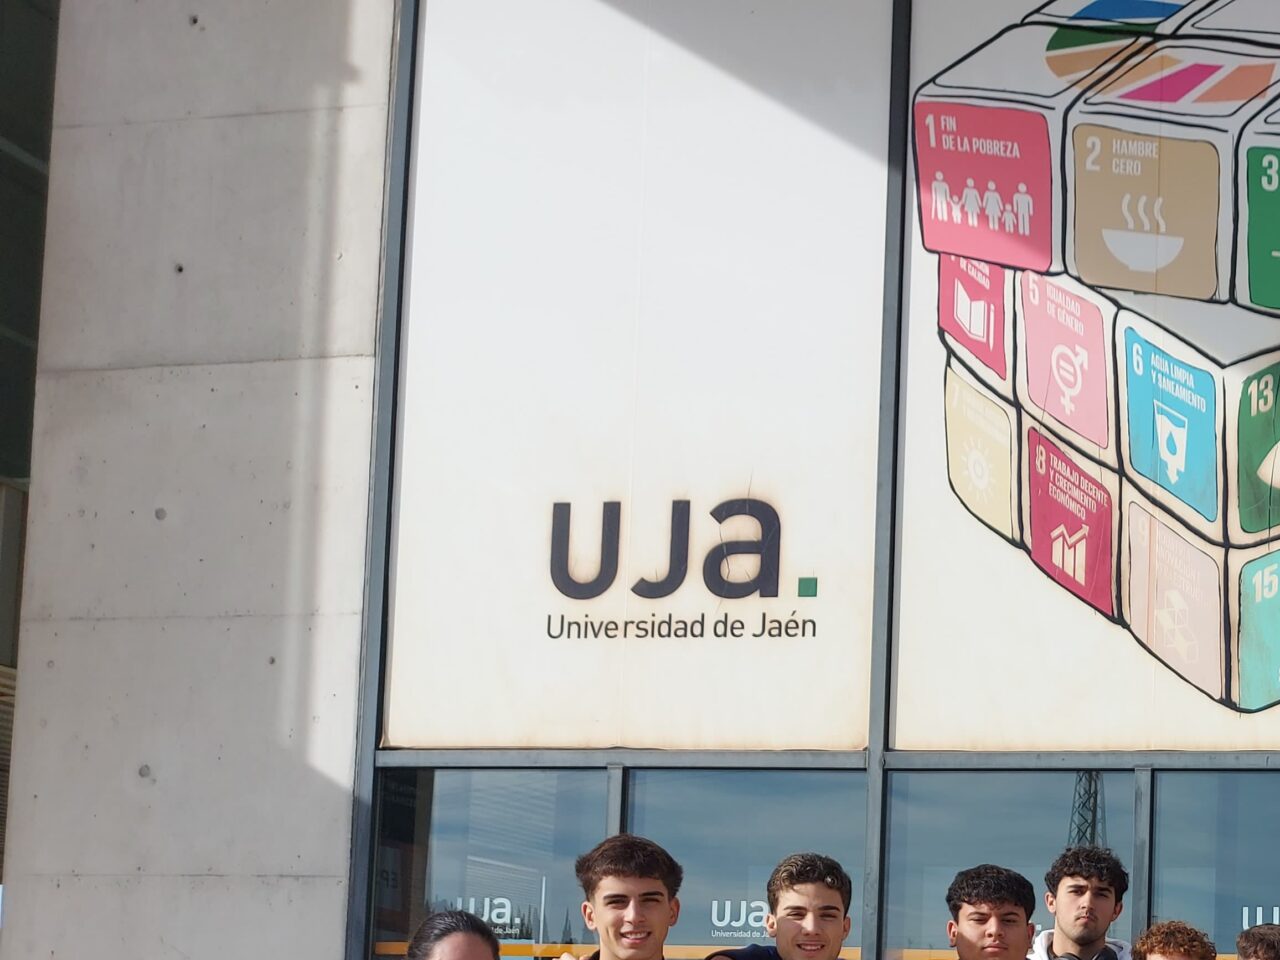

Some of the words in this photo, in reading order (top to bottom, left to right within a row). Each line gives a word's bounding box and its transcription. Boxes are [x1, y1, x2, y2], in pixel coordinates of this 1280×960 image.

[925, 114, 936, 148] 1
[941, 115, 957, 132] FIN
[942, 135, 956, 150] DE
[957, 136, 971, 153] LA
[973, 138, 1021, 159] POBREZA
[1085, 136, 1101, 171] 2
[1112, 139, 1160, 159] HAMBRE
[1112, 159, 1142, 176] CERO
[1261, 154, 1279, 192] 3
[968, 261, 990, 291] CALIDAD
[1029, 272, 1040, 306] 5
[1046, 281, 1081, 317] IGUALDAD
[1047, 301, 1056, 319] DE
[1058, 307, 1084, 337] GÉNERO
[1133, 343, 1143, 376] 6
[1151, 352, 1169, 375] AGUA
[1171, 363, 1195, 389] LIMPIA
[1151, 369, 1157, 385] Y
[1158, 373, 1207, 413] SANEAMIENTO
[1248, 374, 1274, 416] 13
[1036, 444, 1046, 475] 8
[1050, 453, 1080, 486] TRABAJO
[1081, 476, 1108, 507] DECENTE
[1050, 468, 1055, 483] Y
[1056, 473, 1096, 513] CRECIMIENTO
[1049, 482, 1086, 520] ECONÓMICO
[1252, 563, 1278, 603] 15
[546, 613, 705, 639] Universidad
[713, 613, 745, 639] de
[752, 610, 817, 638] Jaén
[711, 930, 750, 938] Universidad
[752, 930, 761, 938] de
